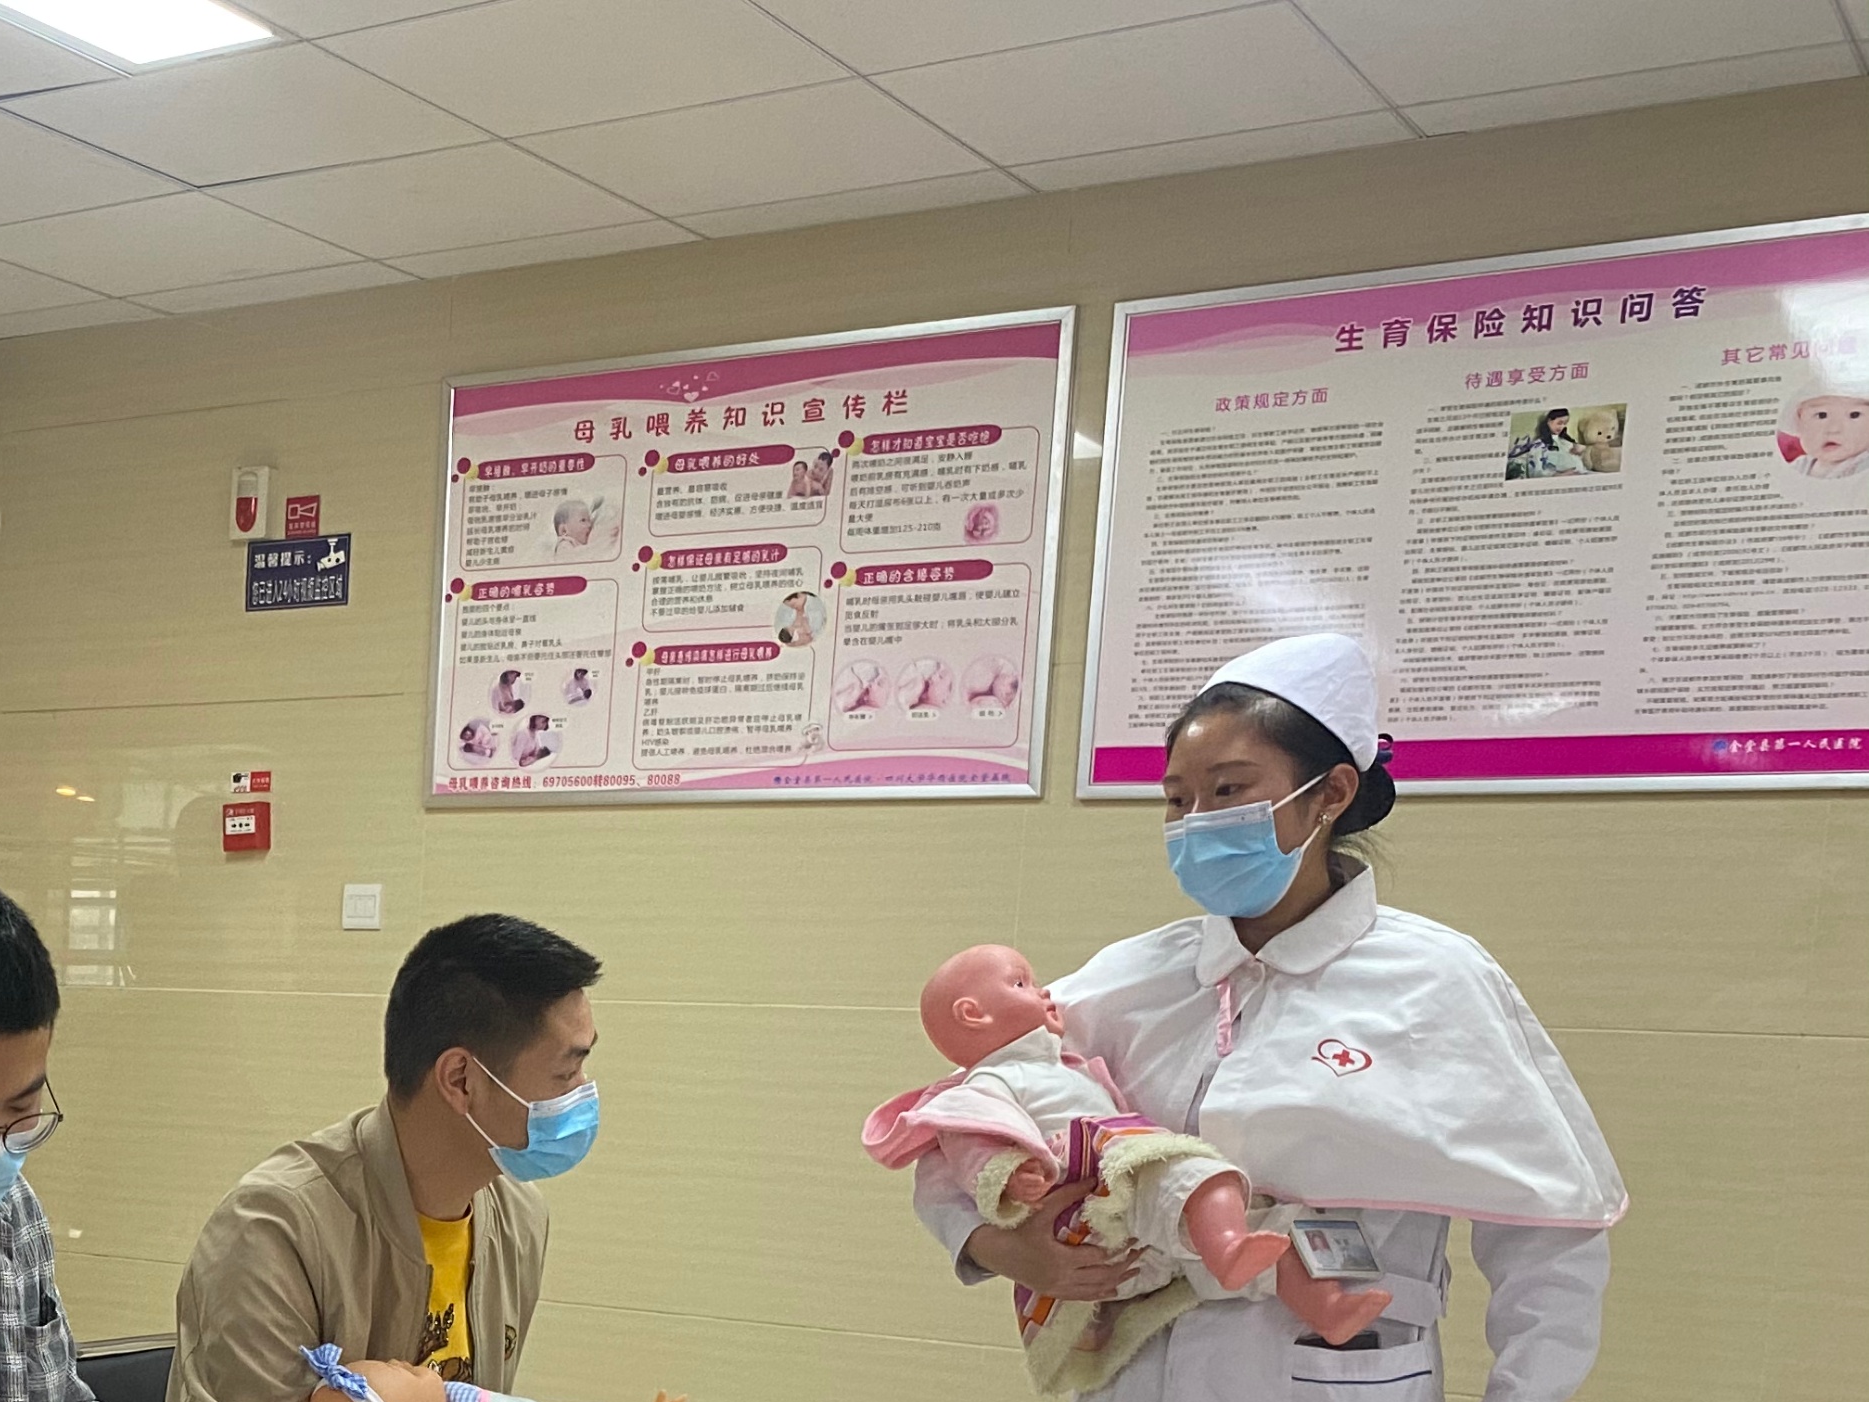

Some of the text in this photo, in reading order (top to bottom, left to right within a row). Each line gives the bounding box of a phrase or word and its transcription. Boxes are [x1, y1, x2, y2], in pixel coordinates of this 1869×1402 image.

[1334, 285, 1708, 354] 生育保险知识问答
[1464, 361, 1590, 391] 待遇享受方面
[1215, 387, 1330, 413] 政策规定方面
[573, 389, 909, 443] 母乳喂养知识宣传栏
[870, 430, 991, 453] 怎样才知道宝宝是否吃饱
[674, 452, 760, 471] 母乳喂养的好处
[863, 566, 955, 585] 正确的含接姿势
